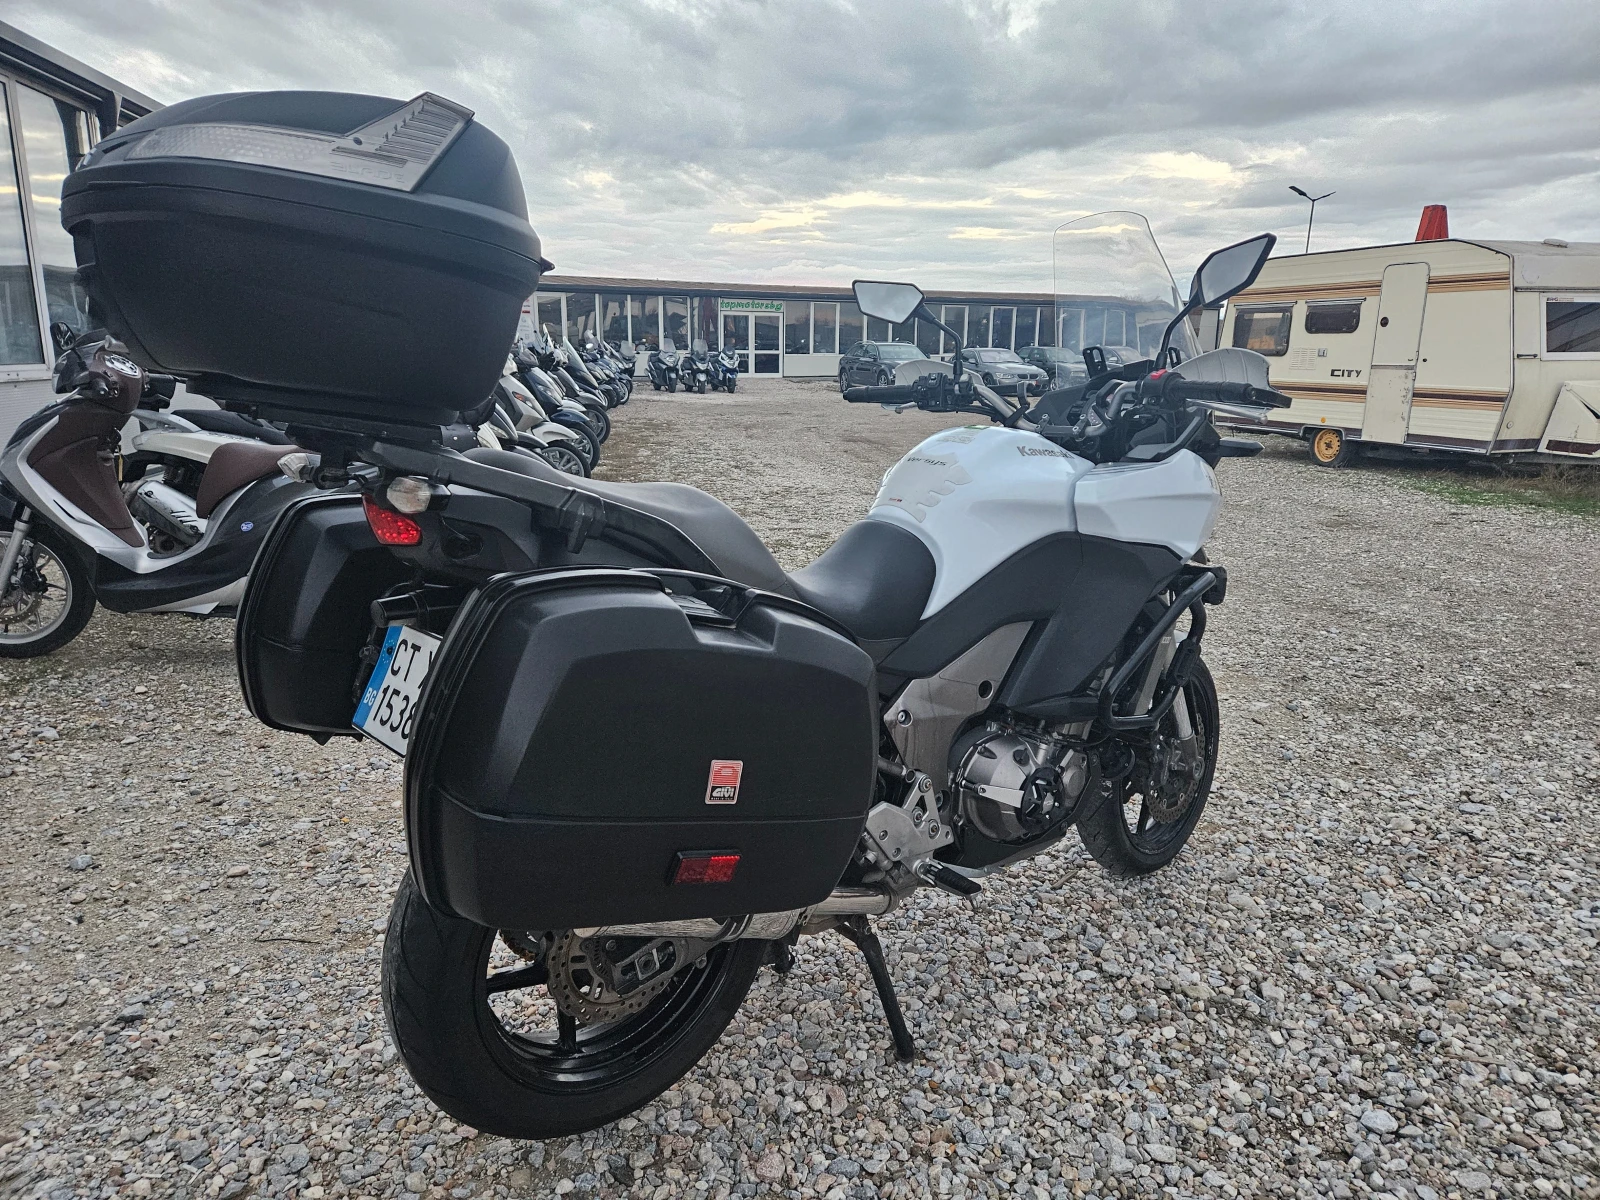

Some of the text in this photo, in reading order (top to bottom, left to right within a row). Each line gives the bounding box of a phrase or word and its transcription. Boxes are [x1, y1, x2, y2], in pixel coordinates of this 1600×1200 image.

[1330, 368, 1362, 378] CITY
[1016, 445, 1076, 460] Kawasaki
[363, 687, 377, 706] BG
[712, 786, 735, 798] GIVI
